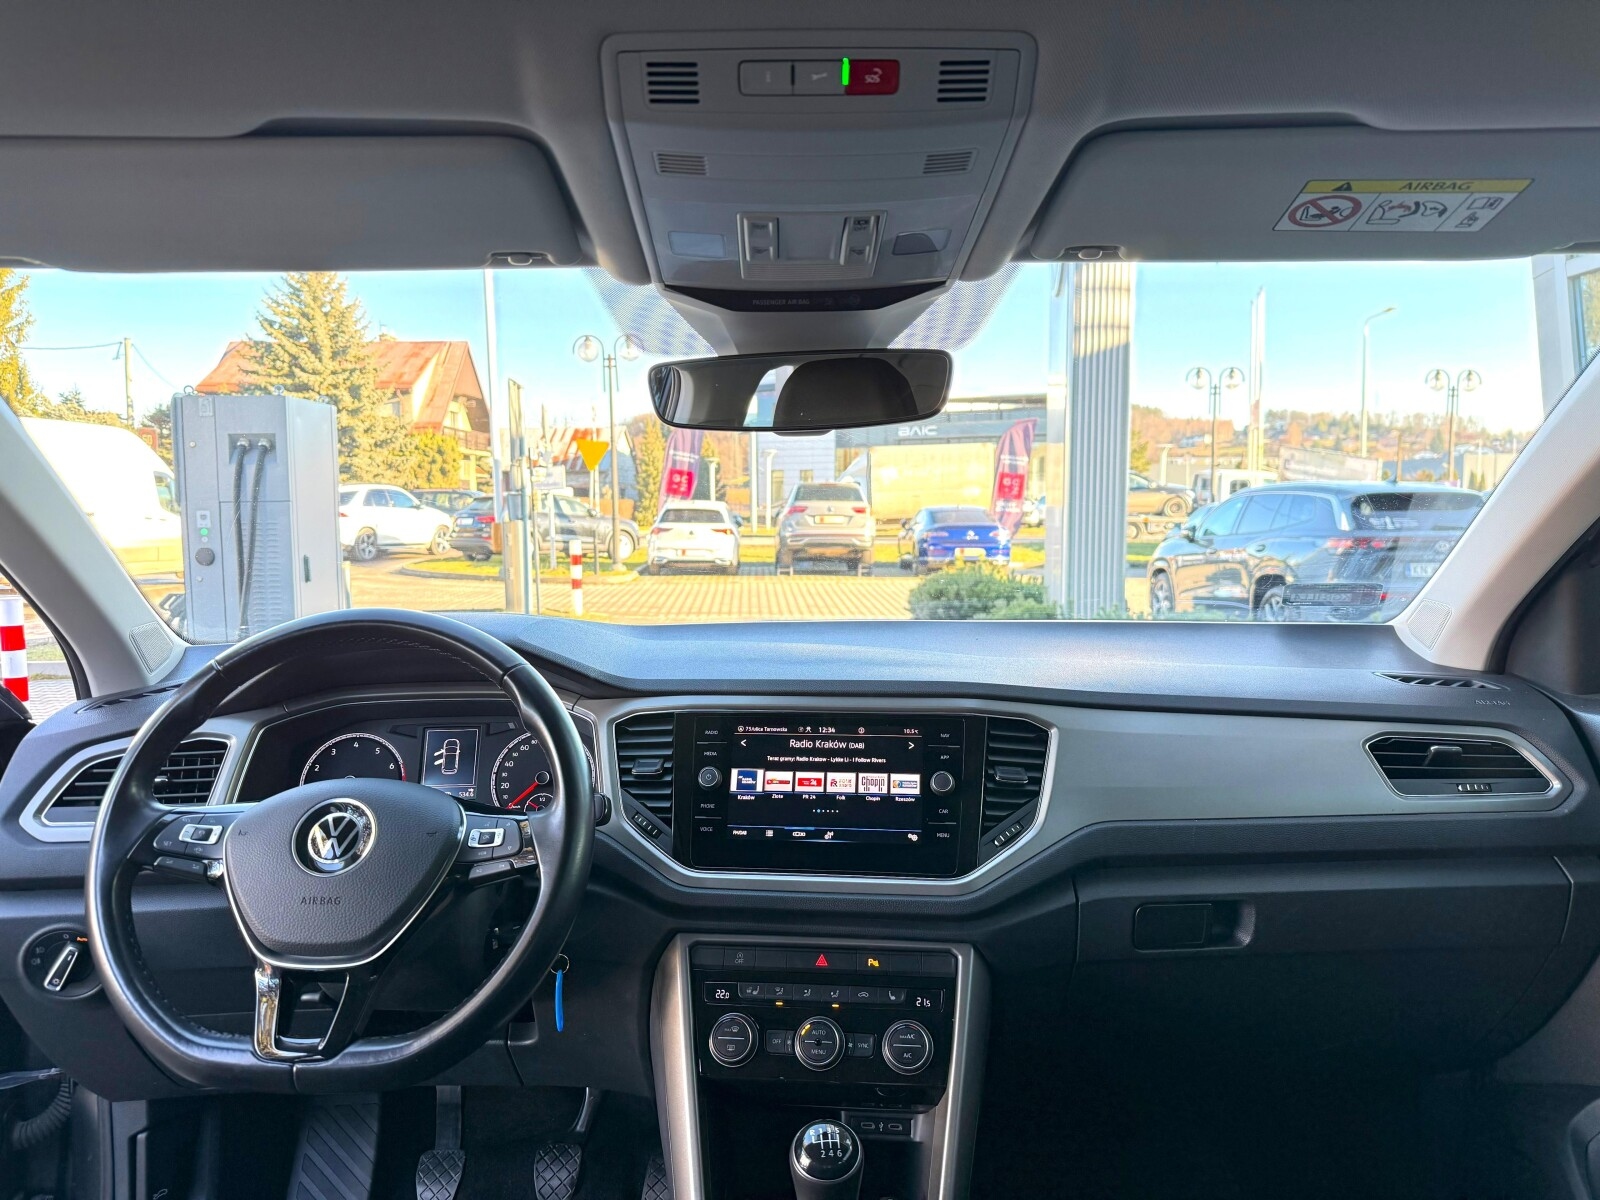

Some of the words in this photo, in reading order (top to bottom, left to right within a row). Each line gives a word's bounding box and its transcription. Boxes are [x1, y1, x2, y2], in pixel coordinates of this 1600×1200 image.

[1399, 181, 1474, 191] AIRBAG
[789, 739, 813, 748] Radio
[815, 740, 847, 749] Kraków
[331, 748, 336, 756] 3
[375, 747, 380, 755] 5
[314, 764, 319, 772] 2
[300, 896, 341, 905] AIRBAG
[820, 1150, 826, 1158] 2
[837, 1150, 843, 1158] 6
